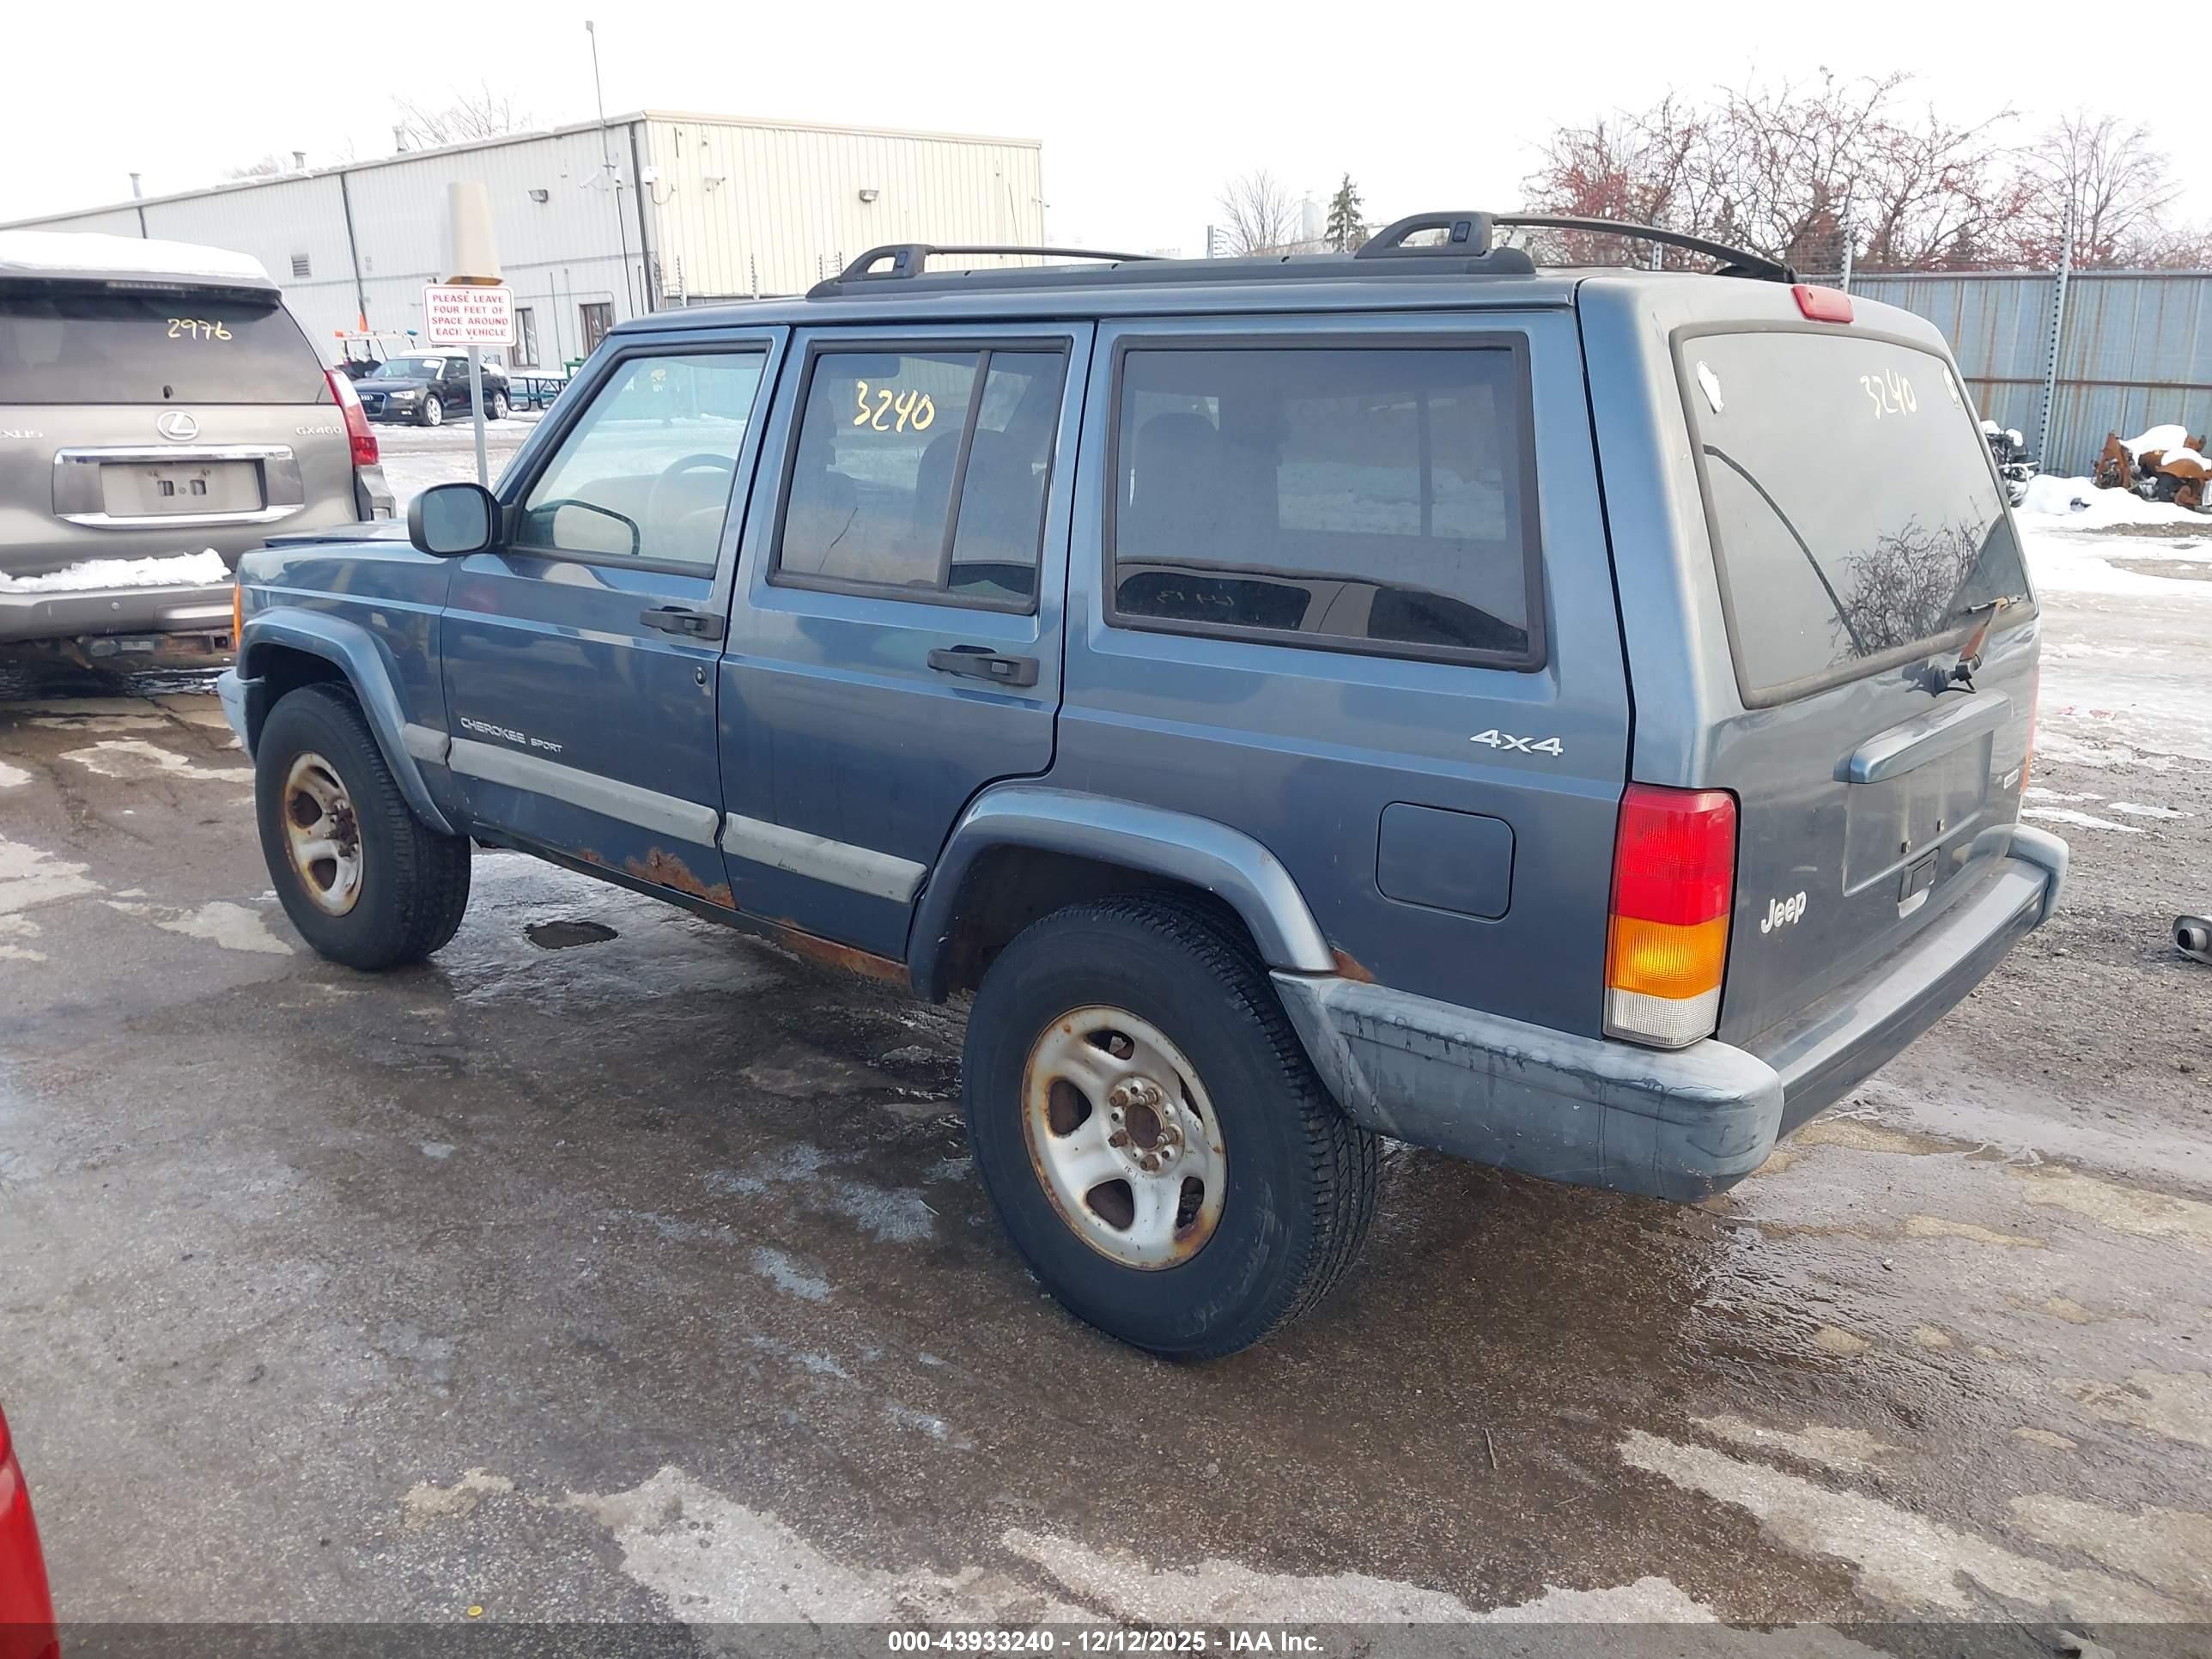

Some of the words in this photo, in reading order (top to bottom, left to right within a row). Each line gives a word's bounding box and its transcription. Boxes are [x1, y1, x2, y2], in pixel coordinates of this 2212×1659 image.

[433, 295, 470, 303] PLEASE
[473, 295, 505, 303] LEAVE
[434, 306, 459, 314] FOUR
[167, 318, 232, 340] 2976
[466, 328, 507, 337] VEHICLE
[853, 380, 935, 433] 3240
[1859, 368, 1917, 420] 3240
[460, 717, 526, 744] CHEROKEE
[530, 738, 563, 753] SPORT
[1760, 890, 1807, 934] Jeep
